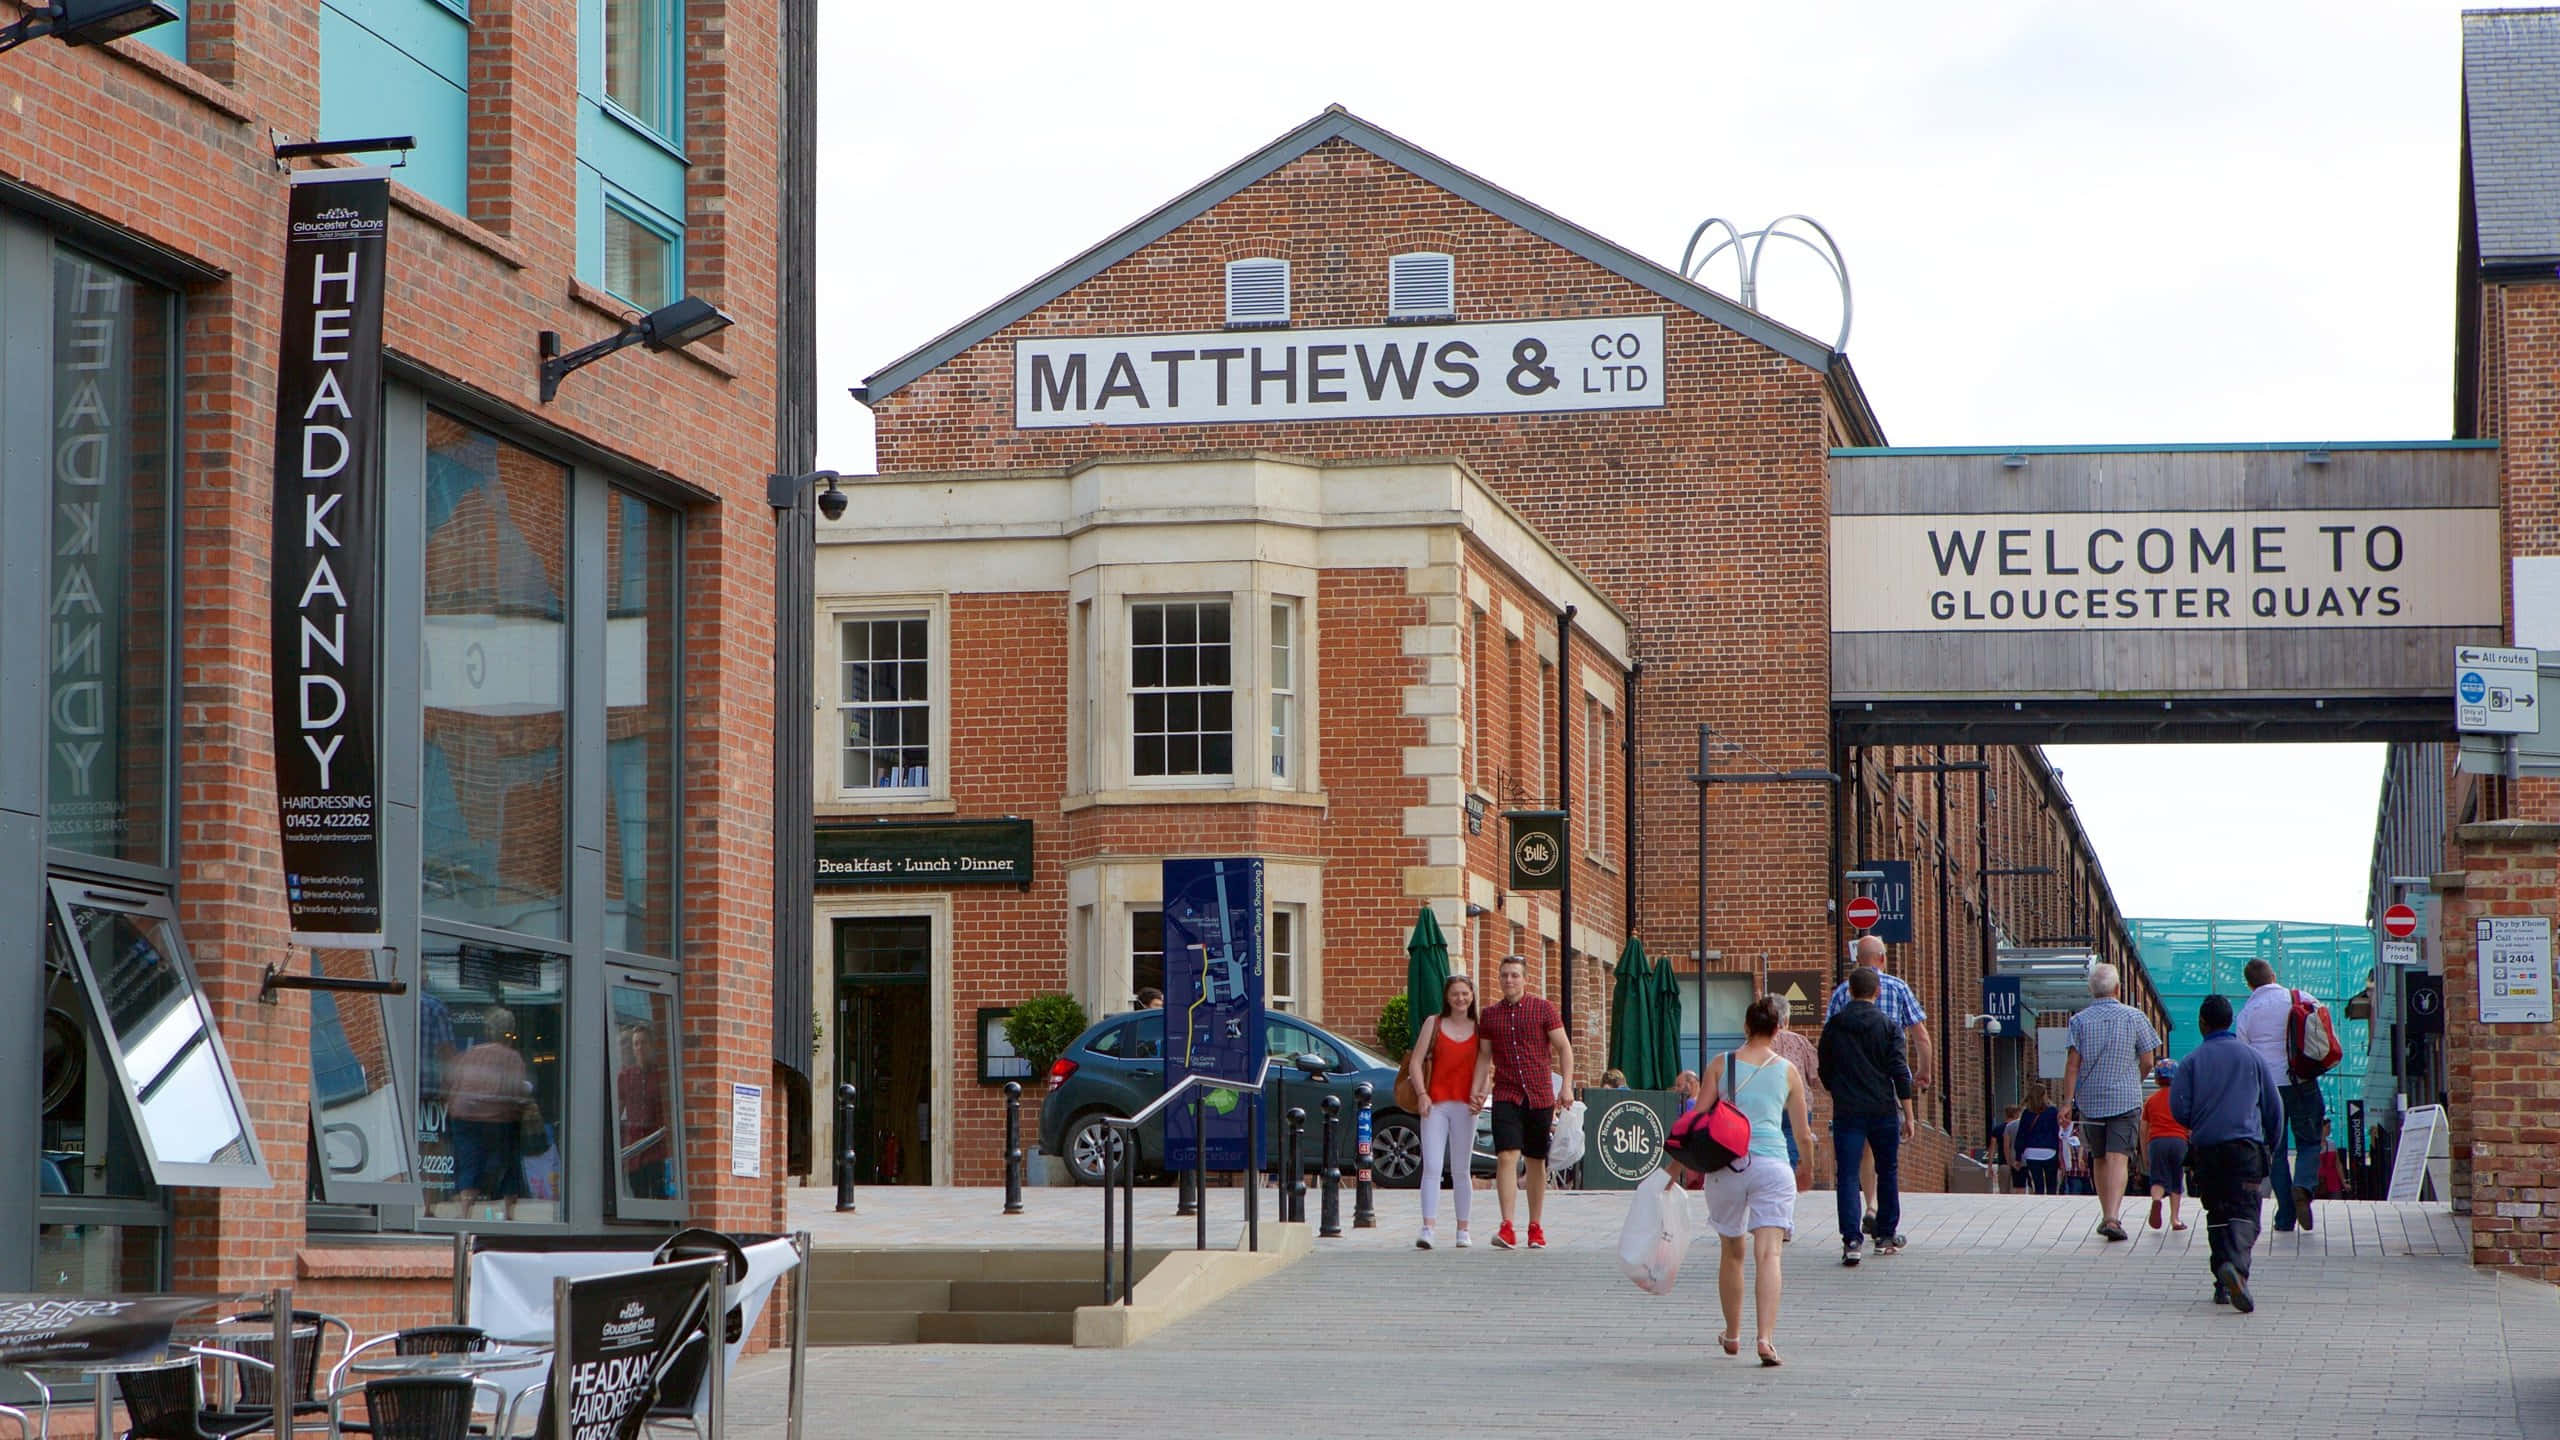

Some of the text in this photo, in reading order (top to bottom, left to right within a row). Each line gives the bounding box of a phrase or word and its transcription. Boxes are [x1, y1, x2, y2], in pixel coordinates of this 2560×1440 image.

[293, 218, 384, 232] Gloucester Quays
[1591, 332, 1641, 359] CO
[1030, 337, 1560, 412] MATTHEWS &
[1583, 364, 1648, 394] LTD
[298, 251, 358, 790] HEADKANDY
[1927, 524, 2404, 576] WELCOME TO
[1930, 586, 2402, 621] GLOUCESTER QUAYS
[2482, 652, 2529, 665] All routes
[282, 795, 372, 809] HAIRDRESSING
[286, 814, 370, 827] 01452 422262
[1523, 843, 1550, 862] Bill's
[818, 856, 1014, 873] Breakfast Lunch Dinner
[1254, 869, 1264, 977] Gloucester Quays Shopping
[2385, 944, 2414, 952] Private
[2508, 954, 2535, 963] 2404
[1988, 991, 2016, 1015] GAP
[1613, 1124, 1650, 1154] Bill's
[602, 1321, 637, 1336] Gloucester
